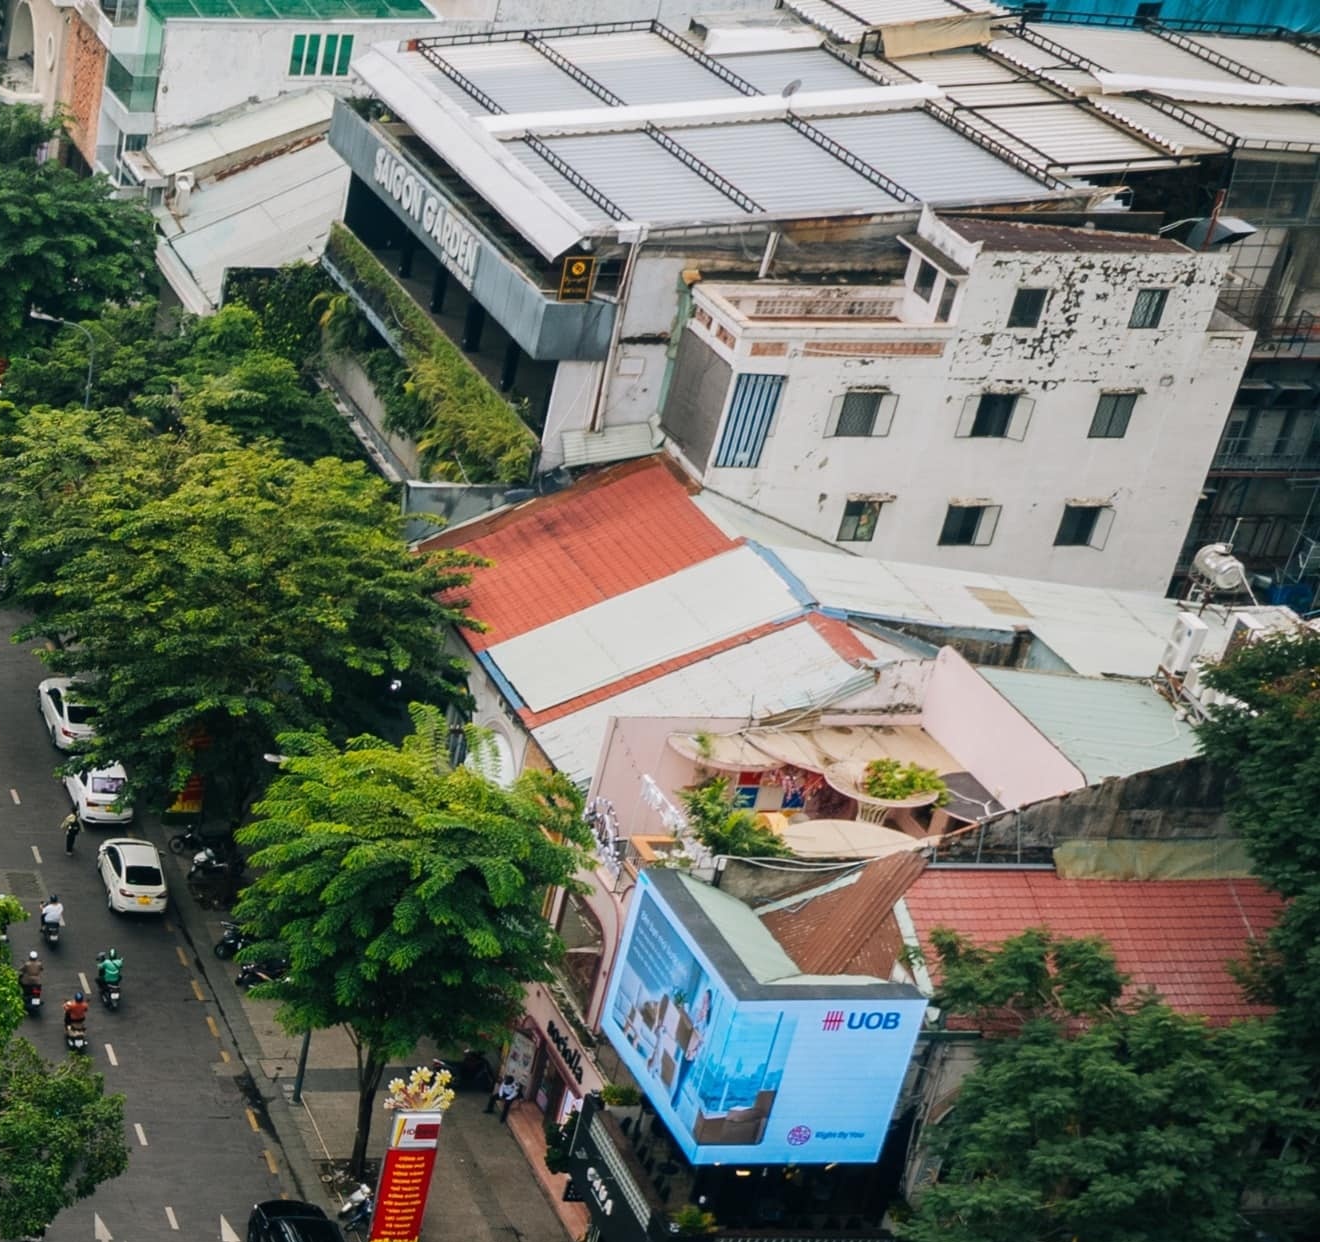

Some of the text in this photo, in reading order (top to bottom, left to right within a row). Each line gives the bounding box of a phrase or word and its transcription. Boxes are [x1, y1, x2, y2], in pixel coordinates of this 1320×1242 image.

[374, 148, 425, 222] SAIGON
[422, 195, 480, 276] GARDEN
[847, 1011, 901, 1031] UOB
